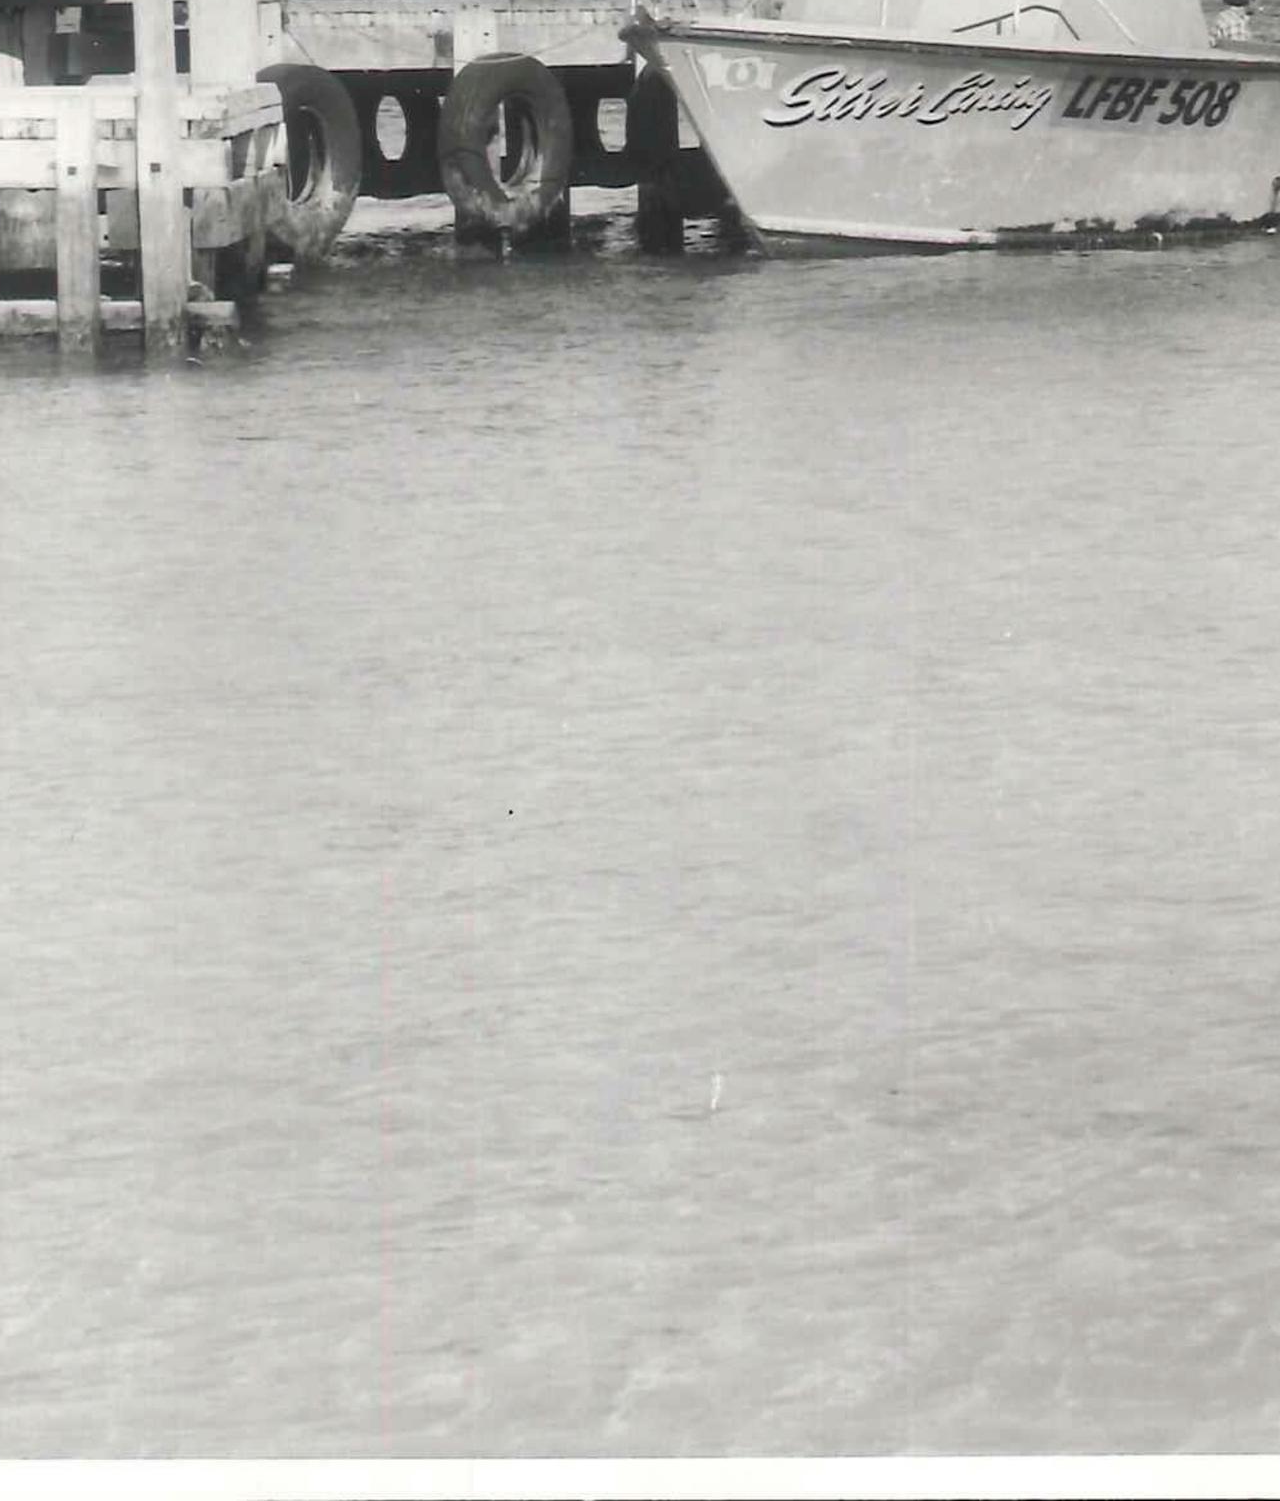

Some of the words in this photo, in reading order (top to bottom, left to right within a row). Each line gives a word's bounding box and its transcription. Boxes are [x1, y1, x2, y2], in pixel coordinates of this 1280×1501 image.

[763, 69, 925, 129] Silver
[917, 71, 1053, 131] Lining
[1062, 75, 1166, 123] LFBF
[1157, 78, 1241, 127] 508
